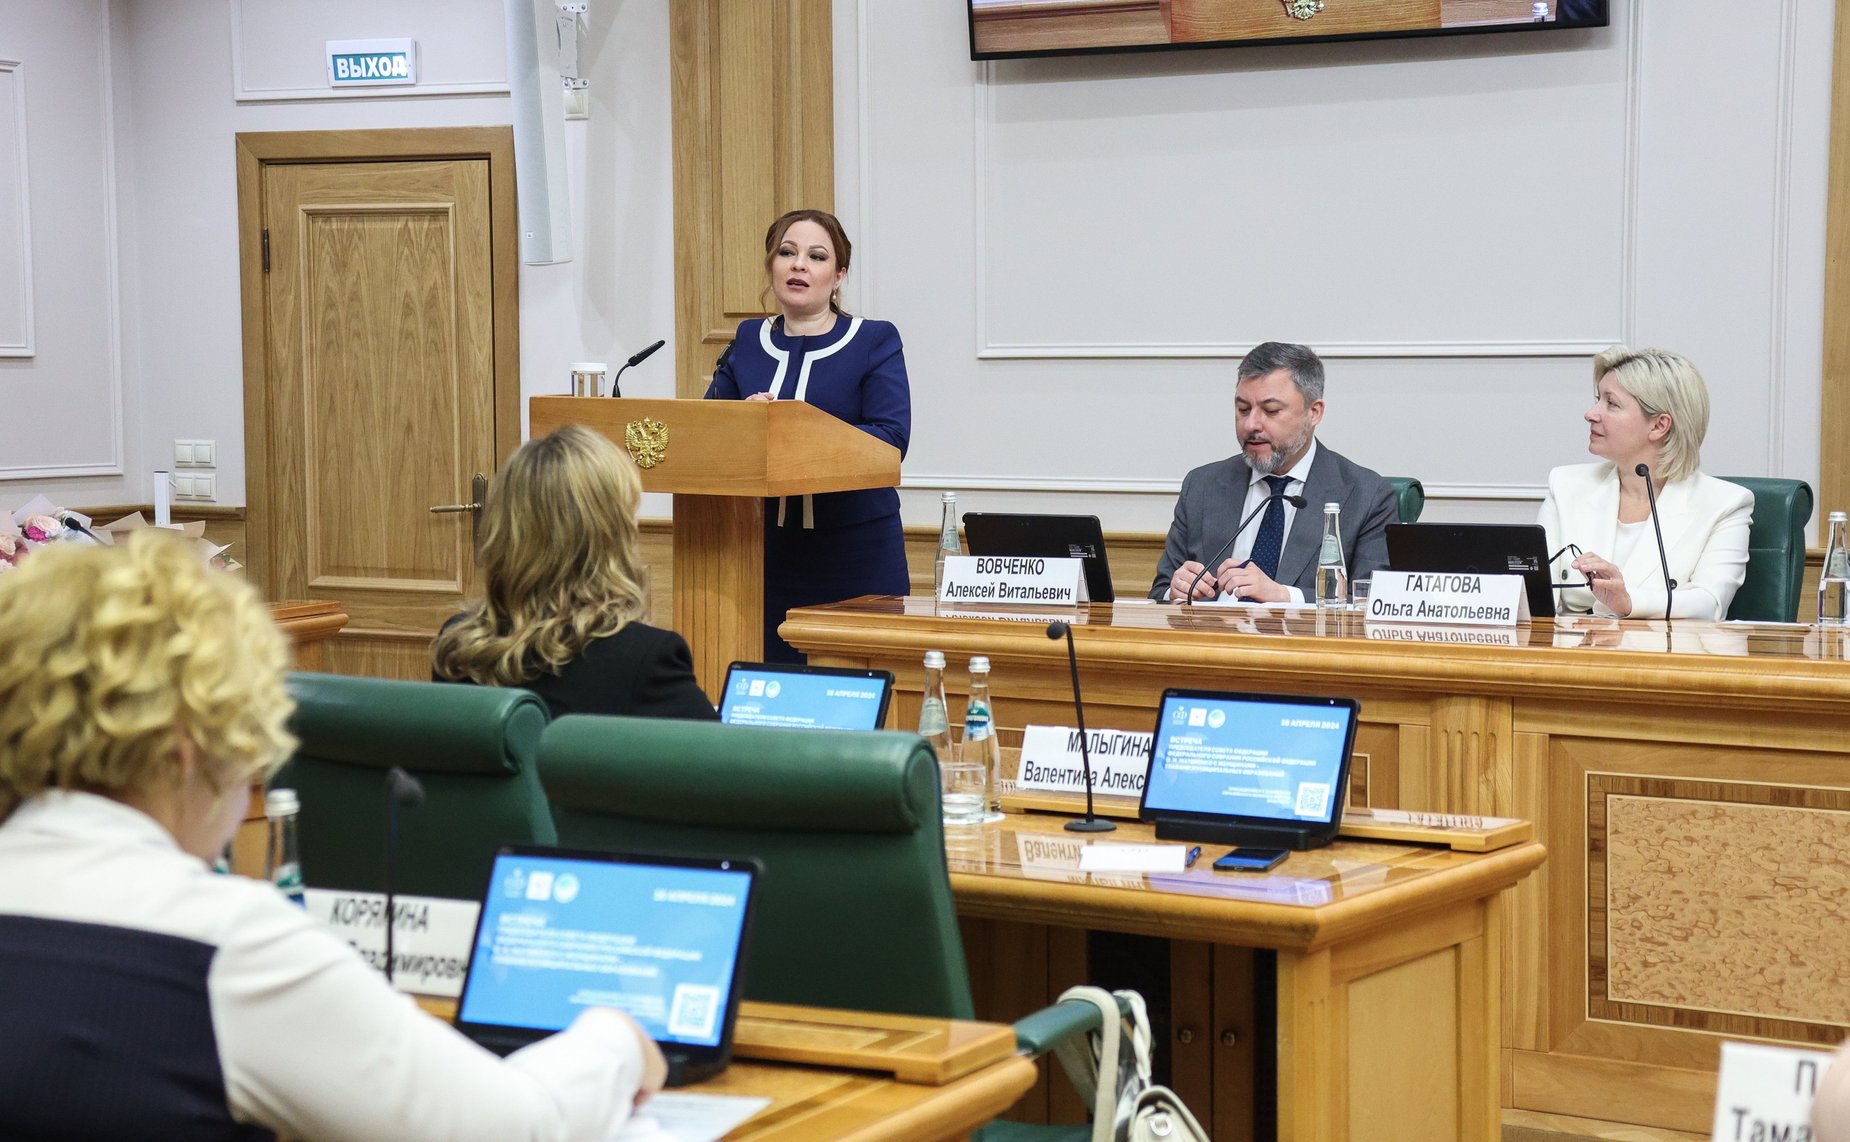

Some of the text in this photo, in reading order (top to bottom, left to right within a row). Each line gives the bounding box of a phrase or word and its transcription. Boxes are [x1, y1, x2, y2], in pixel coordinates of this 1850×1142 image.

[336, 55, 407, 78] ВЫХОД
[976, 558, 1045, 575] ВОВЧЕНКО
[945, 581, 1071, 600] Алексей Витальевич
[1405, 574, 1481, 593] ГАТАГОВА
[1372, 598, 1510, 620] Ольга Анатольевна
[1101, 766, 1145, 790] Алекс
